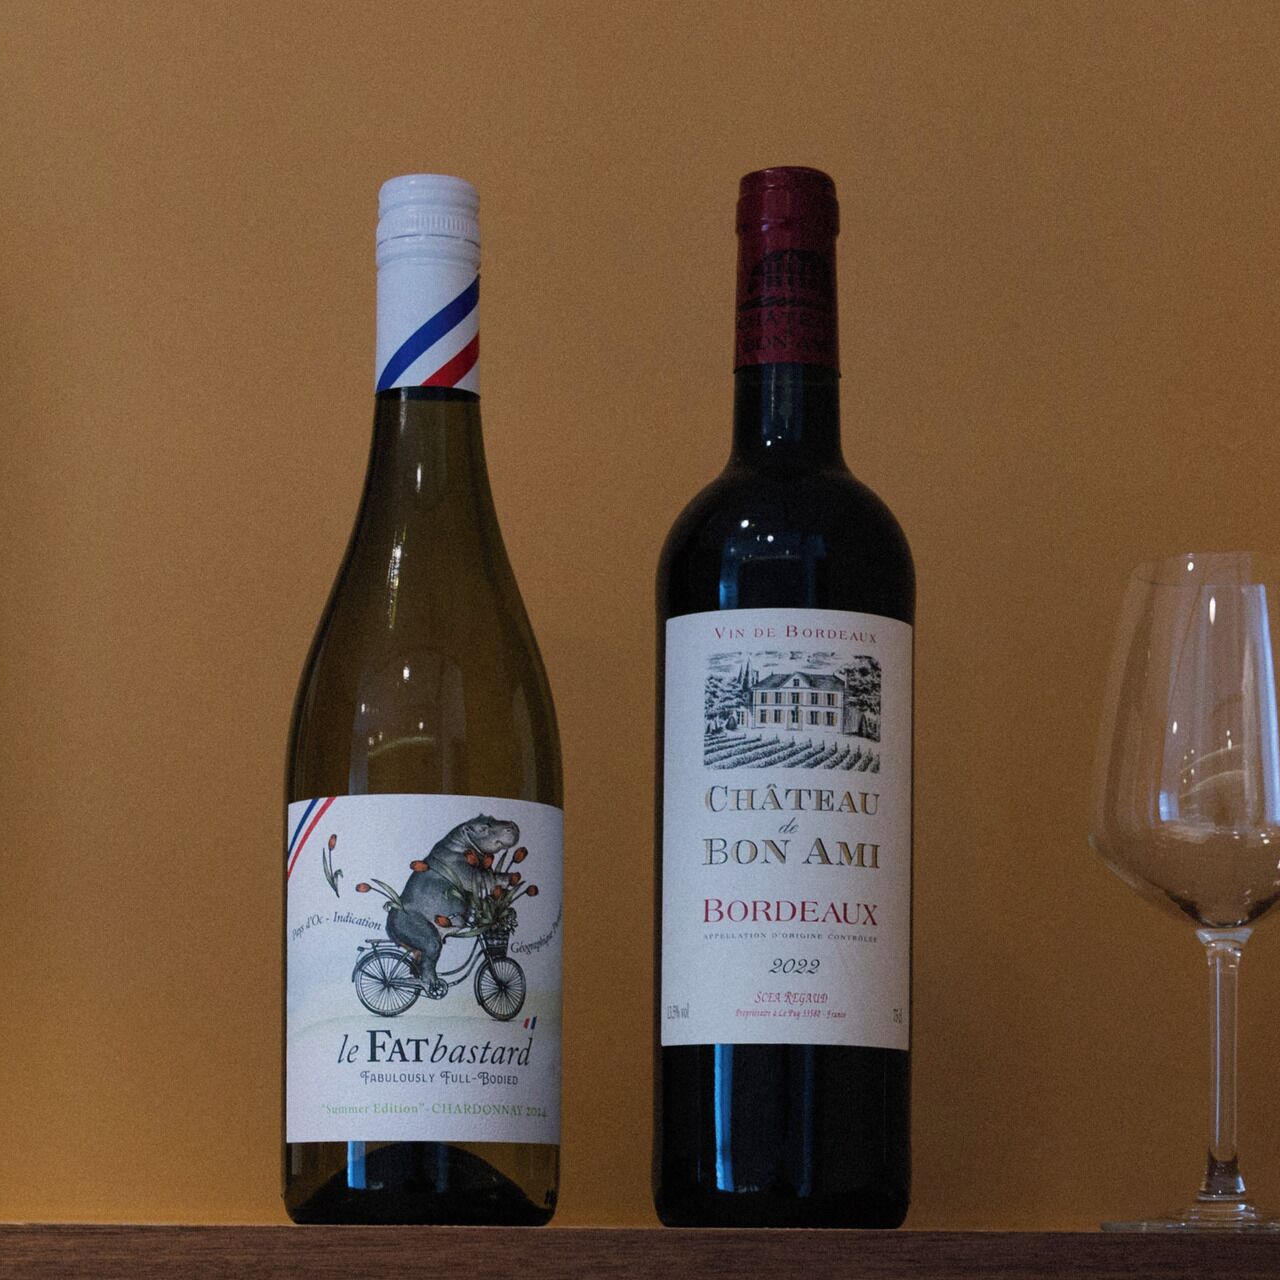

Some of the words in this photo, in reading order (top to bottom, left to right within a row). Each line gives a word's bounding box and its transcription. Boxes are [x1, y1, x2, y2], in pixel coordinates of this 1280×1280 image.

[713, 627, 745, 640] VIN
[754, 628, 776, 638] DE
[786, 624, 878, 644] BORDEAUX
[704, 783, 881, 816] CHÂTEAU
[778, 817, 800, 834] de
[701, 838, 792, 866] BON
[802, 837, 881, 869] AMI
[333, 911, 382, 931] Indication
[702, 898, 878, 926] BORDEAUX
[703, 932, 767, 941] APPELLATION
[772, 932, 822, 940] D'ORIGINE
[768, 958, 821, 975] 2022
[337, 1034, 360, 1064] le
[360, 1070, 435, 1085] FABULOUSLY
[440, 1070, 518, 1086] FULL-BODIED
[431, 1103, 523, 1117] CHARDONNAY
